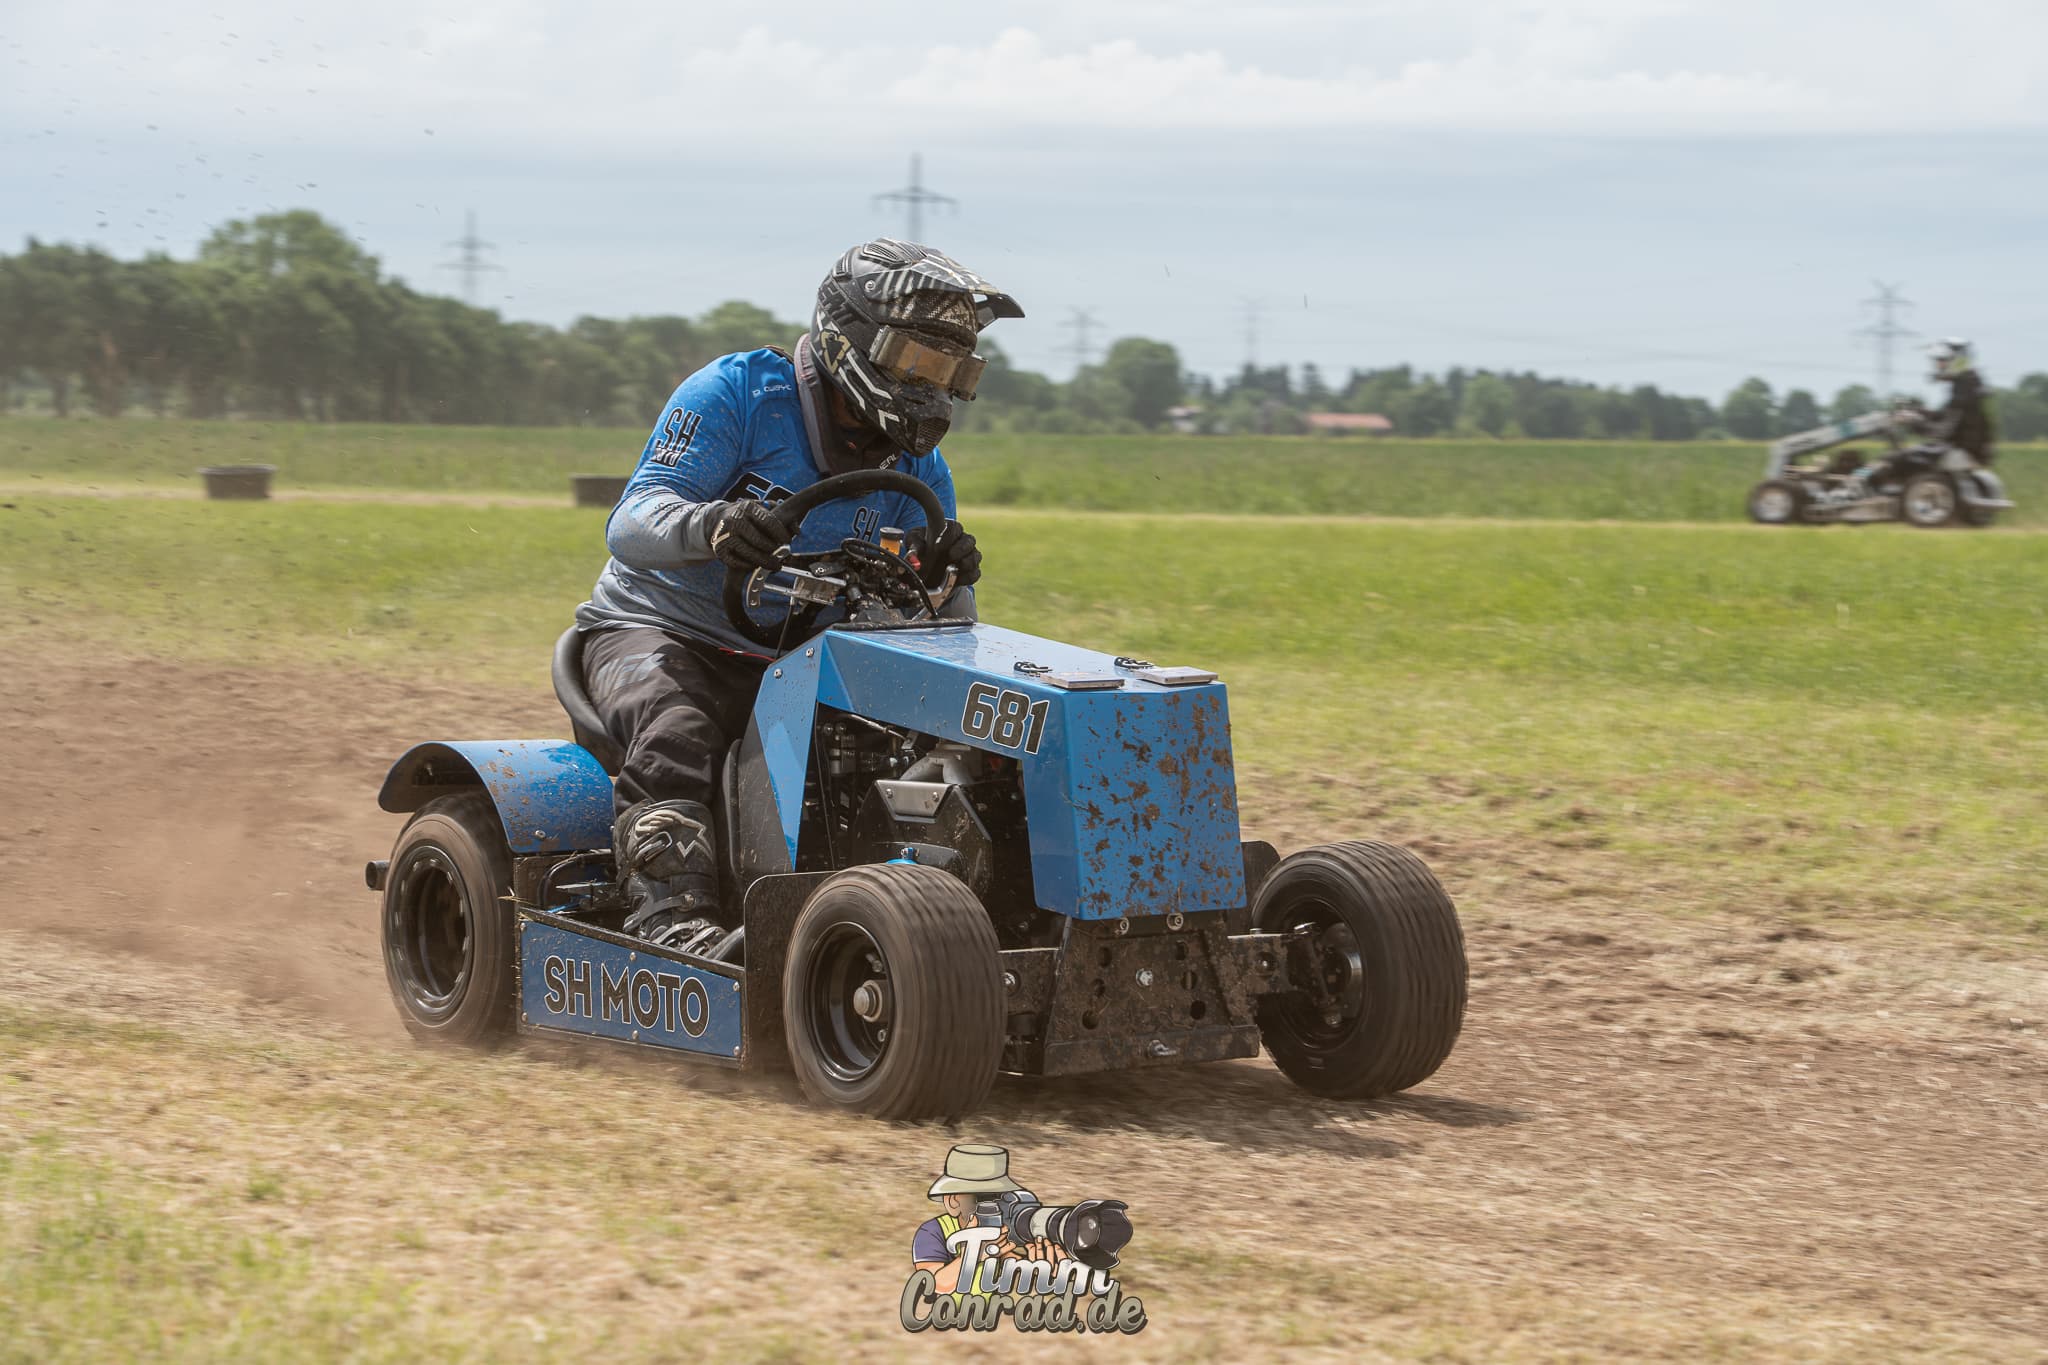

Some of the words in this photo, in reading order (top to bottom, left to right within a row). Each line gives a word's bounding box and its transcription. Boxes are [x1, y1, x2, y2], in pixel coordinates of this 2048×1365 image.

[655, 406, 702, 453] SH
[961, 681, 1051, 755] 681
[543, 955, 593, 1018] SH
[601, 962, 710, 1038] MOTO
